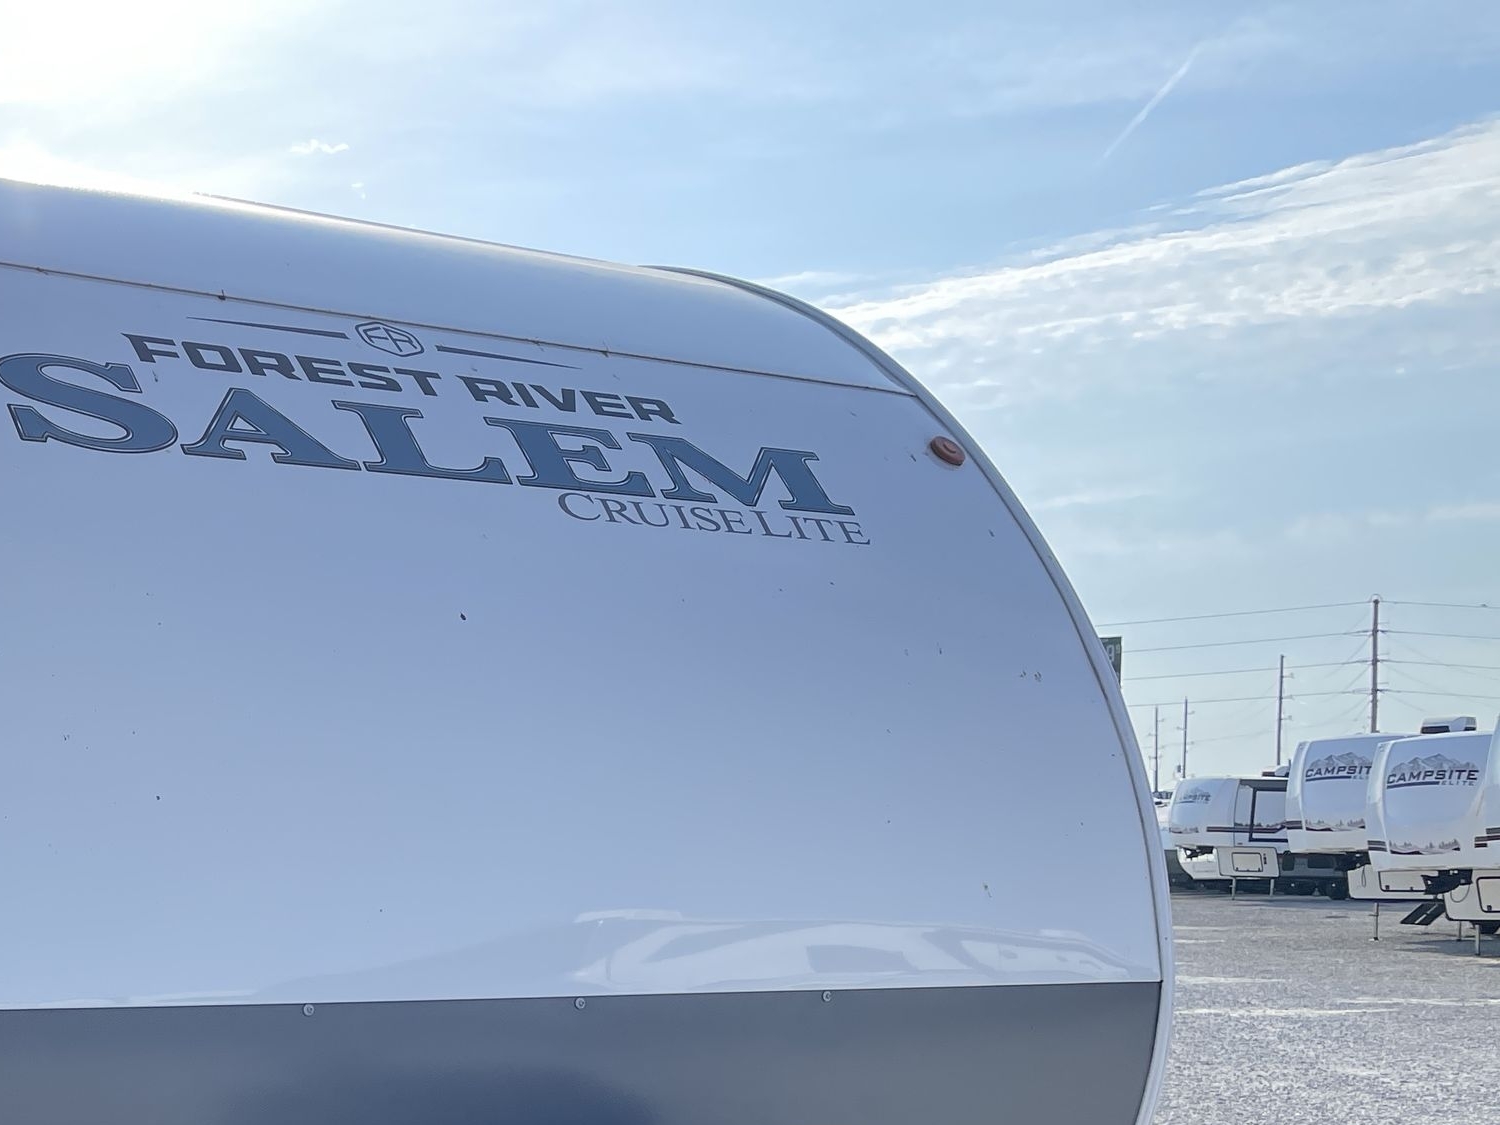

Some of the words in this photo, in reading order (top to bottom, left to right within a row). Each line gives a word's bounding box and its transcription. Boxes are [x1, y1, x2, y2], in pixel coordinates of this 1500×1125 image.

[122, 332, 442, 397] FOREST
[456, 375, 682, 425] RIVER
[1305, 765, 1372, 778] CAMPSIT
[1387, 769, 1479, 785] CAMPSITE
